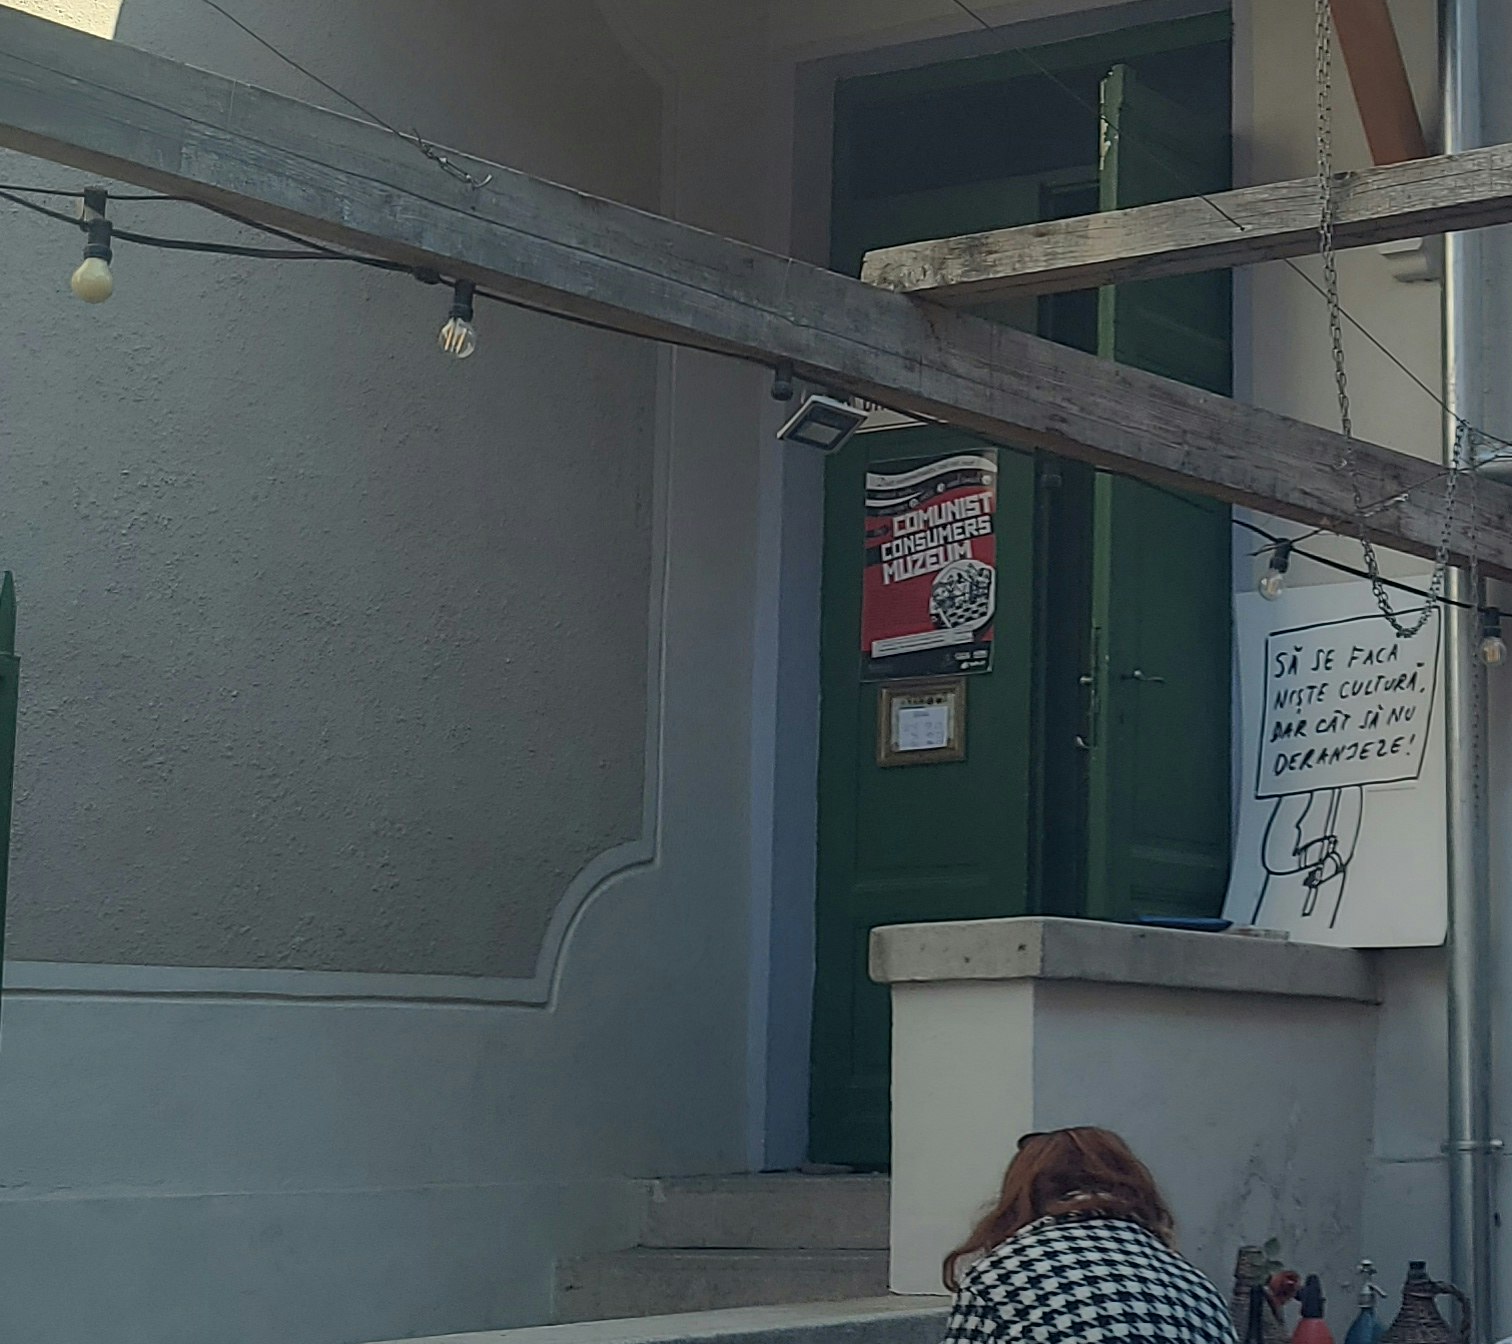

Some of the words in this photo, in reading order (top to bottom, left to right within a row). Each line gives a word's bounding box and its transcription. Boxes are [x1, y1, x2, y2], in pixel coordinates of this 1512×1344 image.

[893, 492, 993, 537] COMUNIST
[881, 515, 992, 561] CONSUMERS
[882, 539, 973, 585] MUZEUM
[1273, 645, 1303, 678] SĂ
[1311, 649, 1335, 671] SE
[1270, 719, 1307, 743] DAR
[1386, 706, 1417, 726] NU
